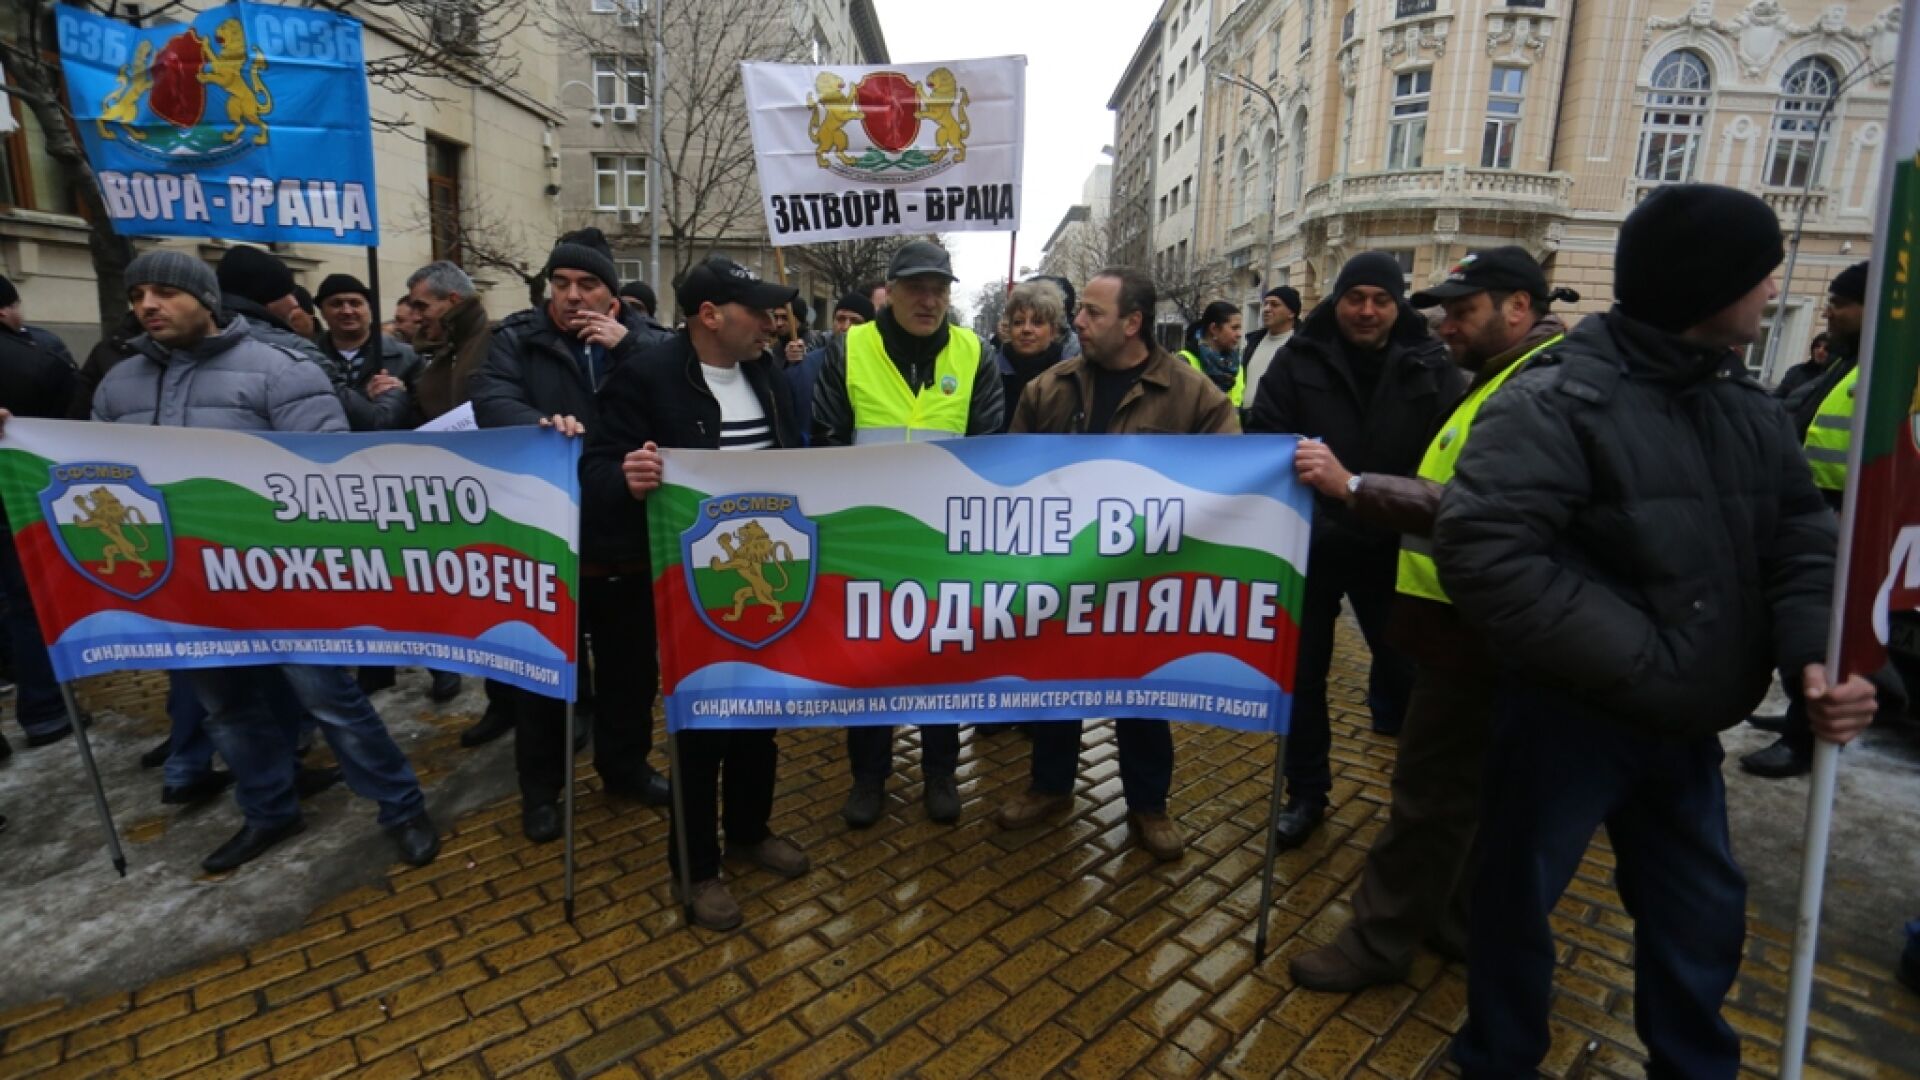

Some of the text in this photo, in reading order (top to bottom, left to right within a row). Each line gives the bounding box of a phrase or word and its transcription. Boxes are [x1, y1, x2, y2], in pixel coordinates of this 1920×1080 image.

[58, 14, 127, 66] СЗБ
[99, 170, 210, 221] ВОРА
[227, 175, 372, 237] ВРАЦА
[770, 189, 901, 234] ЗАТВОРА
[924, 183, 1014, 226] ВРАЦА
[57, 465, 134, 481] СФСМВР
[264, 473, 489, 532] ЗАЕДНО
[706, 496, 792, 518] СФСМВР
[947, 497, 1184, 556] НИЕ ВИ
[201, 546, 558, 613] МОЖЕМ ПОВЕЧЕ
[844, 577, 1279, 654] ПОДКРЕПЯМЕ
[82, 638, 560, 686] СИНДИКАЛНА ФЕДЕРАЦИЯ НА СЛУЖИТЕЛИТЕ В МИНИСТЕРСТВО НА ВЪТРЕШНИТЕ РАБОТИ
[692, 690, 1268, 719] СИНДИКАЛНА ФЕДЕРАЦИЯ НА СЛУЖИТЕЛИТЕ В МИНИСТЕРСТВО НА ВЪТРЕШНИТЕ РАБОТИ
